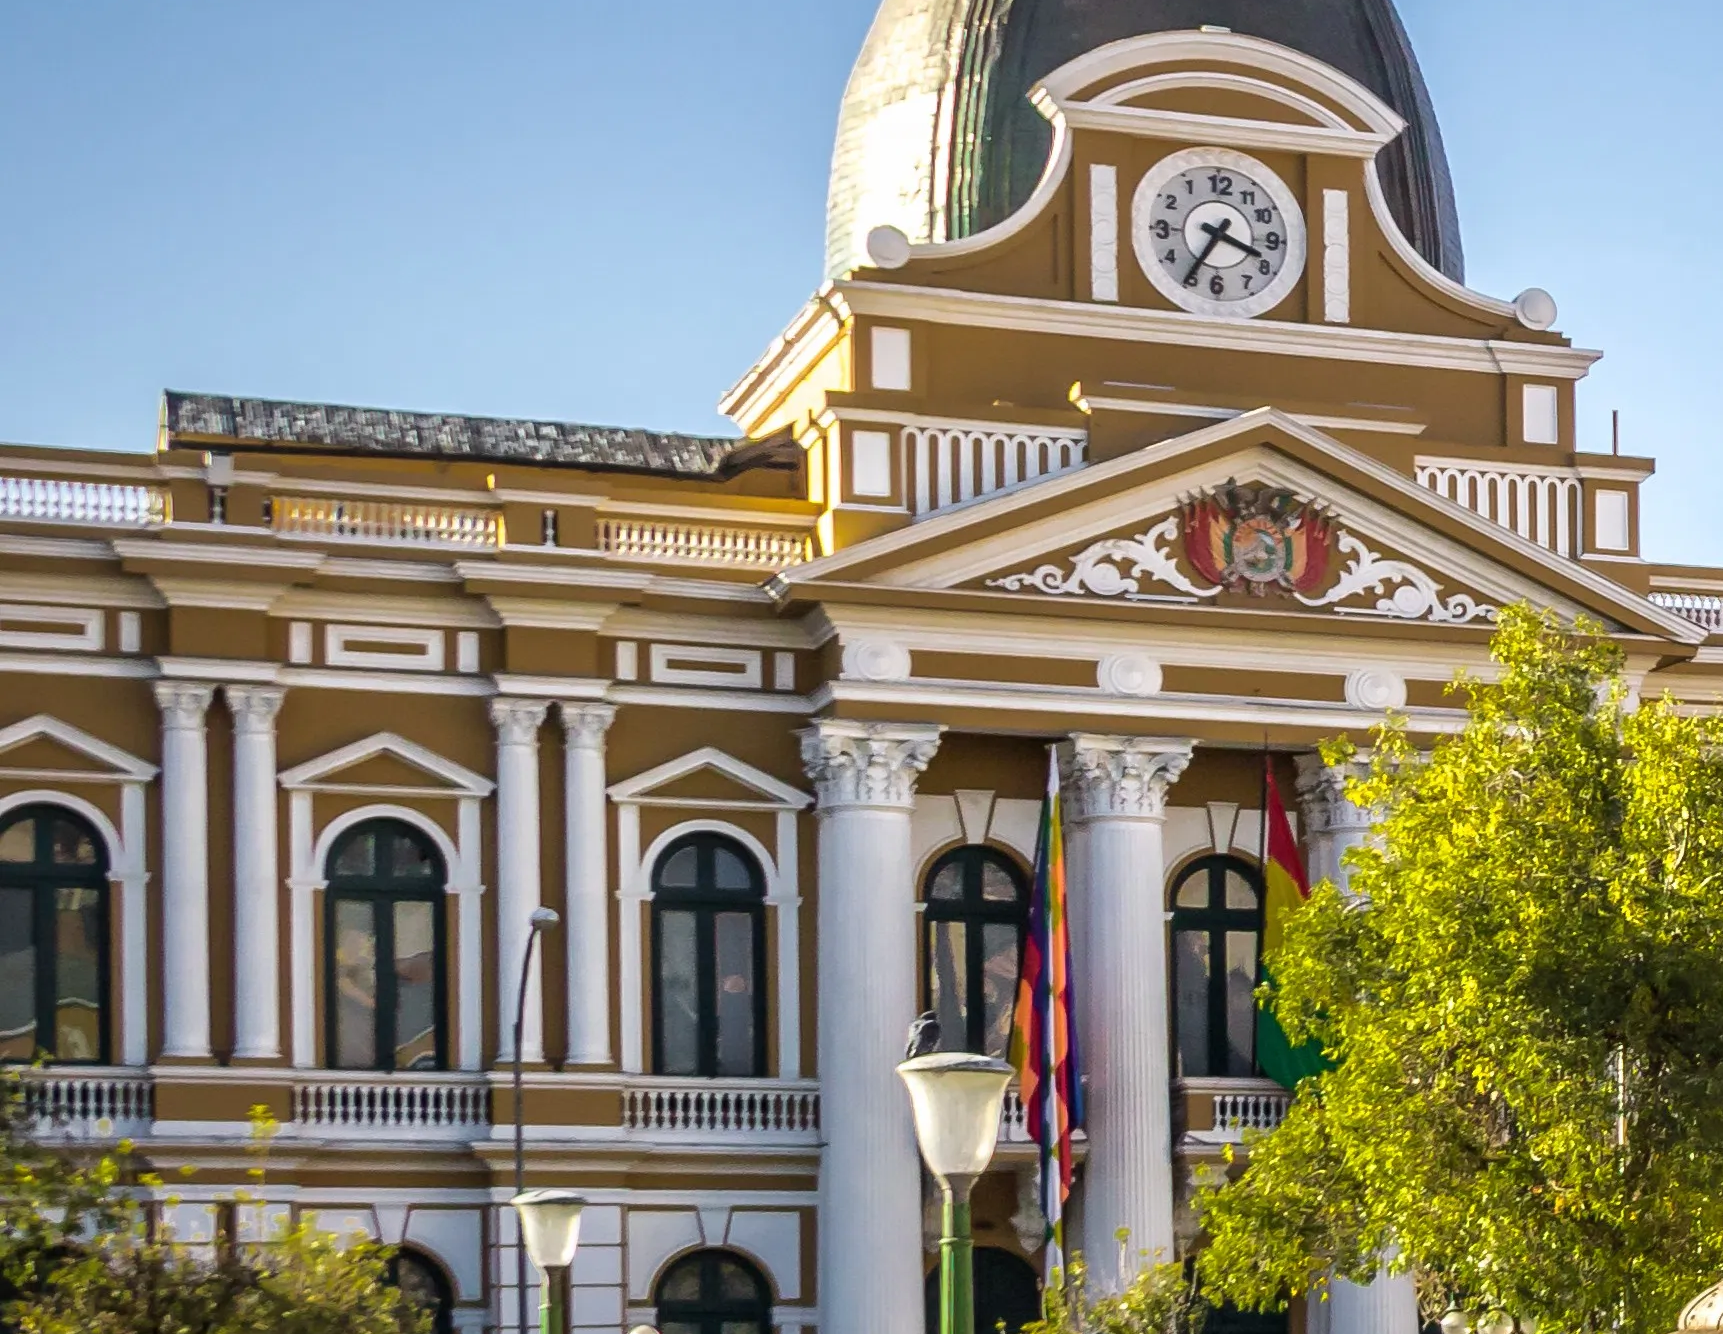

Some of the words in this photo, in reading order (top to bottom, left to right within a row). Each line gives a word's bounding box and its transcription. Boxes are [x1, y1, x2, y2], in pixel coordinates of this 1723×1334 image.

[1184, 179, 1194, 195] 1
[1208, 174, 1233, 196] 12
[1165, 194, 1178, 210] 2
[1239, 190, 1255, 206] 11
[1254, 208, 1272, 224] 10
[1155, 219, 1169, 239] 3
[1265, 231, 1279, 251] 9
[1165, 249, 1176, 264] 4
[1258, 259, 1270, 275] 8
[1209, 275, 1224, 295] 6
[1241, 274, 1253, 289] 7
